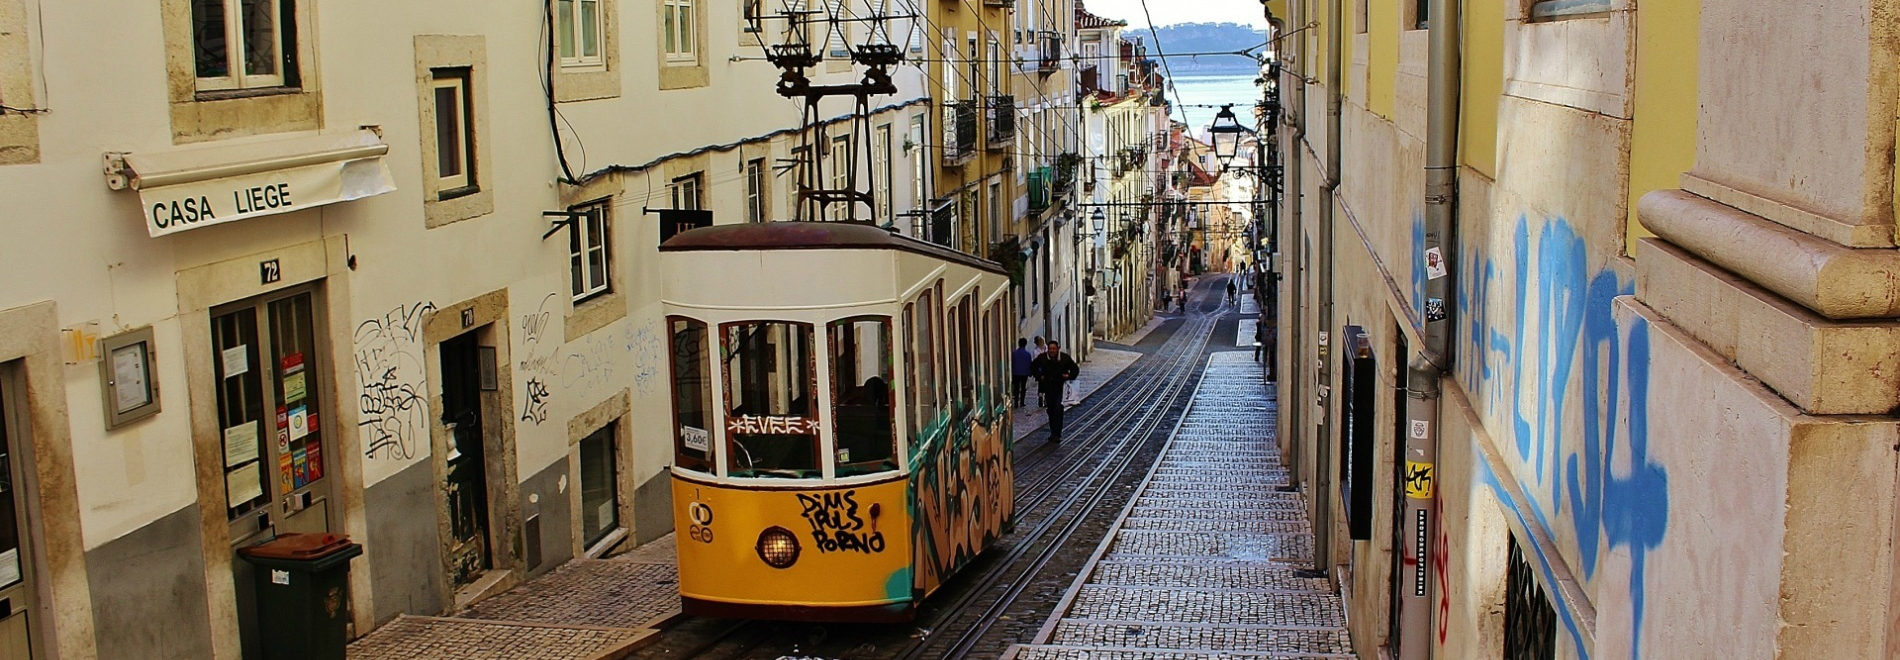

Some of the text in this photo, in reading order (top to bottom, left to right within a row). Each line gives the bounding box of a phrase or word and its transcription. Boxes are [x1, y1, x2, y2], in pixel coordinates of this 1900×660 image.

[153, 183, 292, 228] CASA LIEGE
[264, 261, 278, 281] 72
[686, 432, 707, 446] 3,60€
